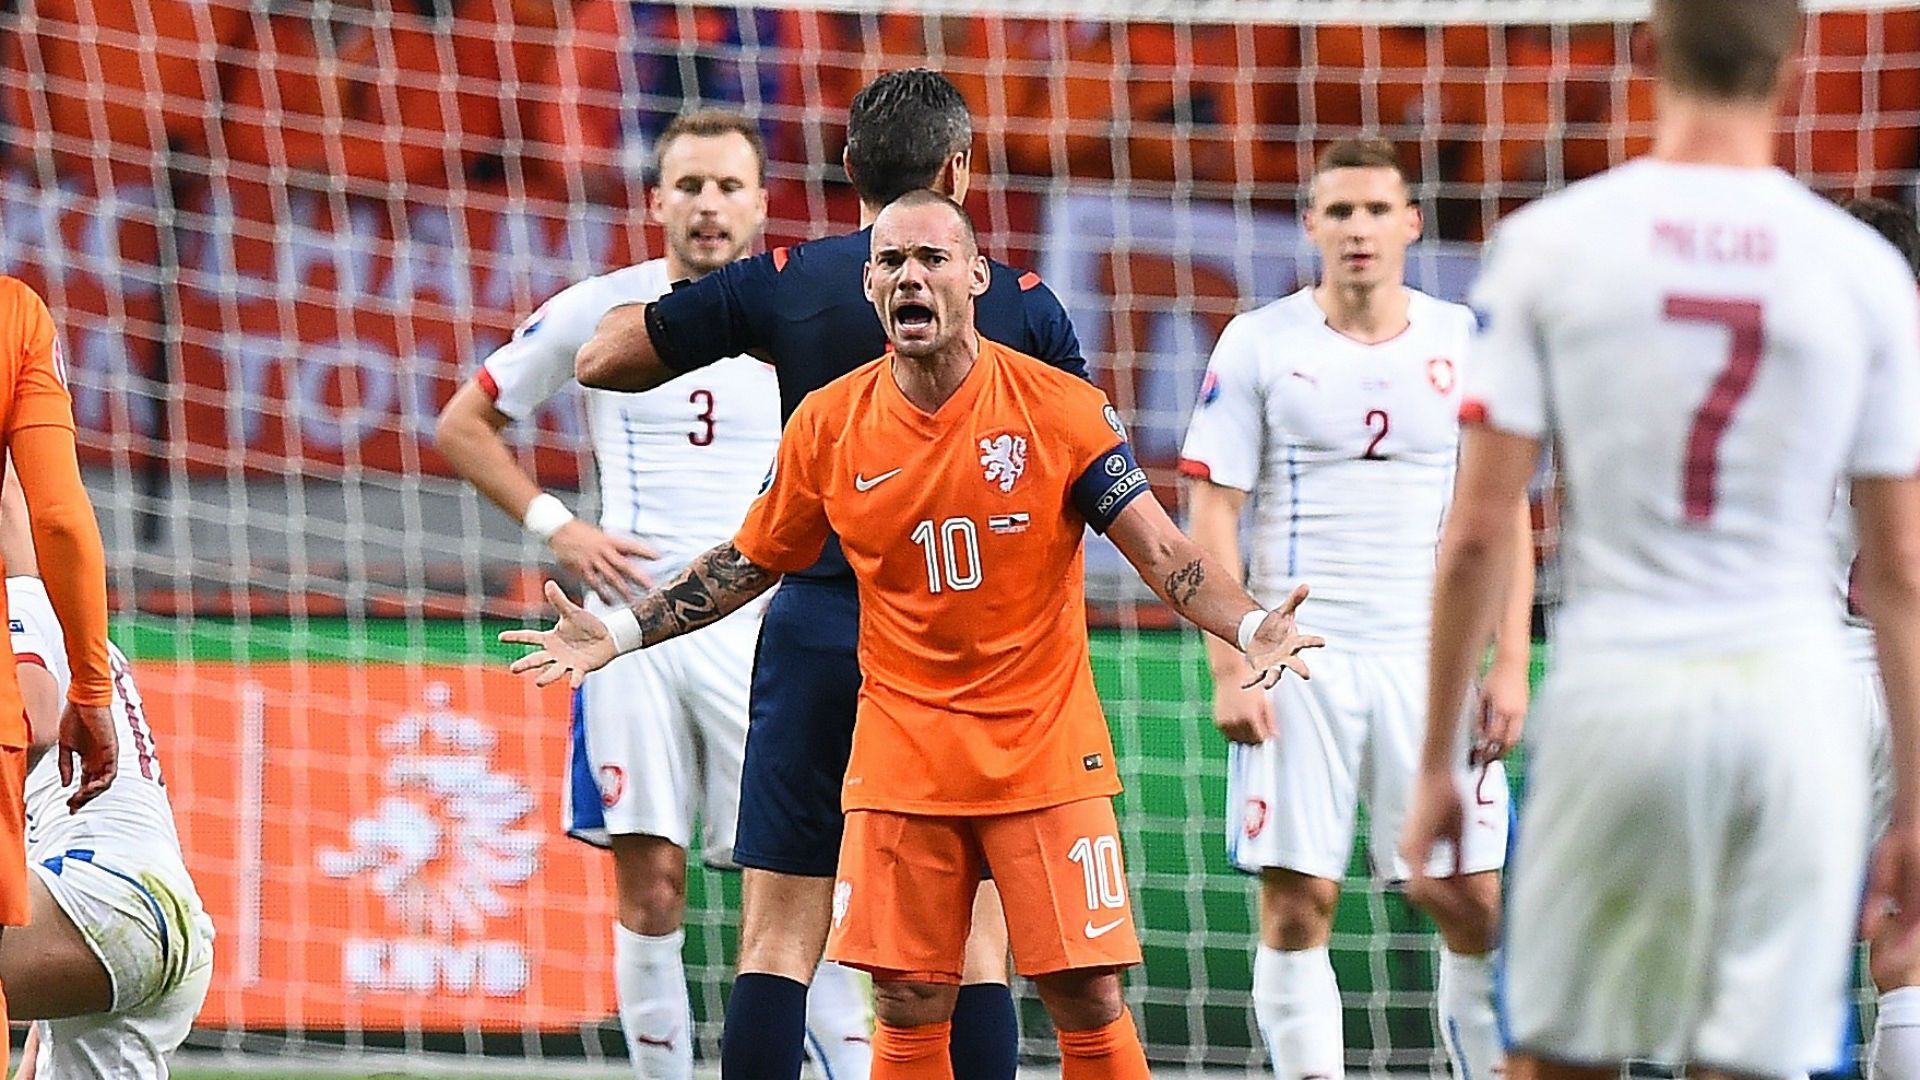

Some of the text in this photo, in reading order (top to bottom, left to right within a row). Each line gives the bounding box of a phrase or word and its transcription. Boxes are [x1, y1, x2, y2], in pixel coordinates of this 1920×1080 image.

[688, 389, 714, 447] 3
[1364, 410, 1390, 461] 2
[1662, 294, 1766, 523] 7
[1098, 496, 1114, 514] NO
[1112, 482, 1128, 496] TO
[910, 517, 982, 595] 10
[1068, 835, 1126, 911] 10
